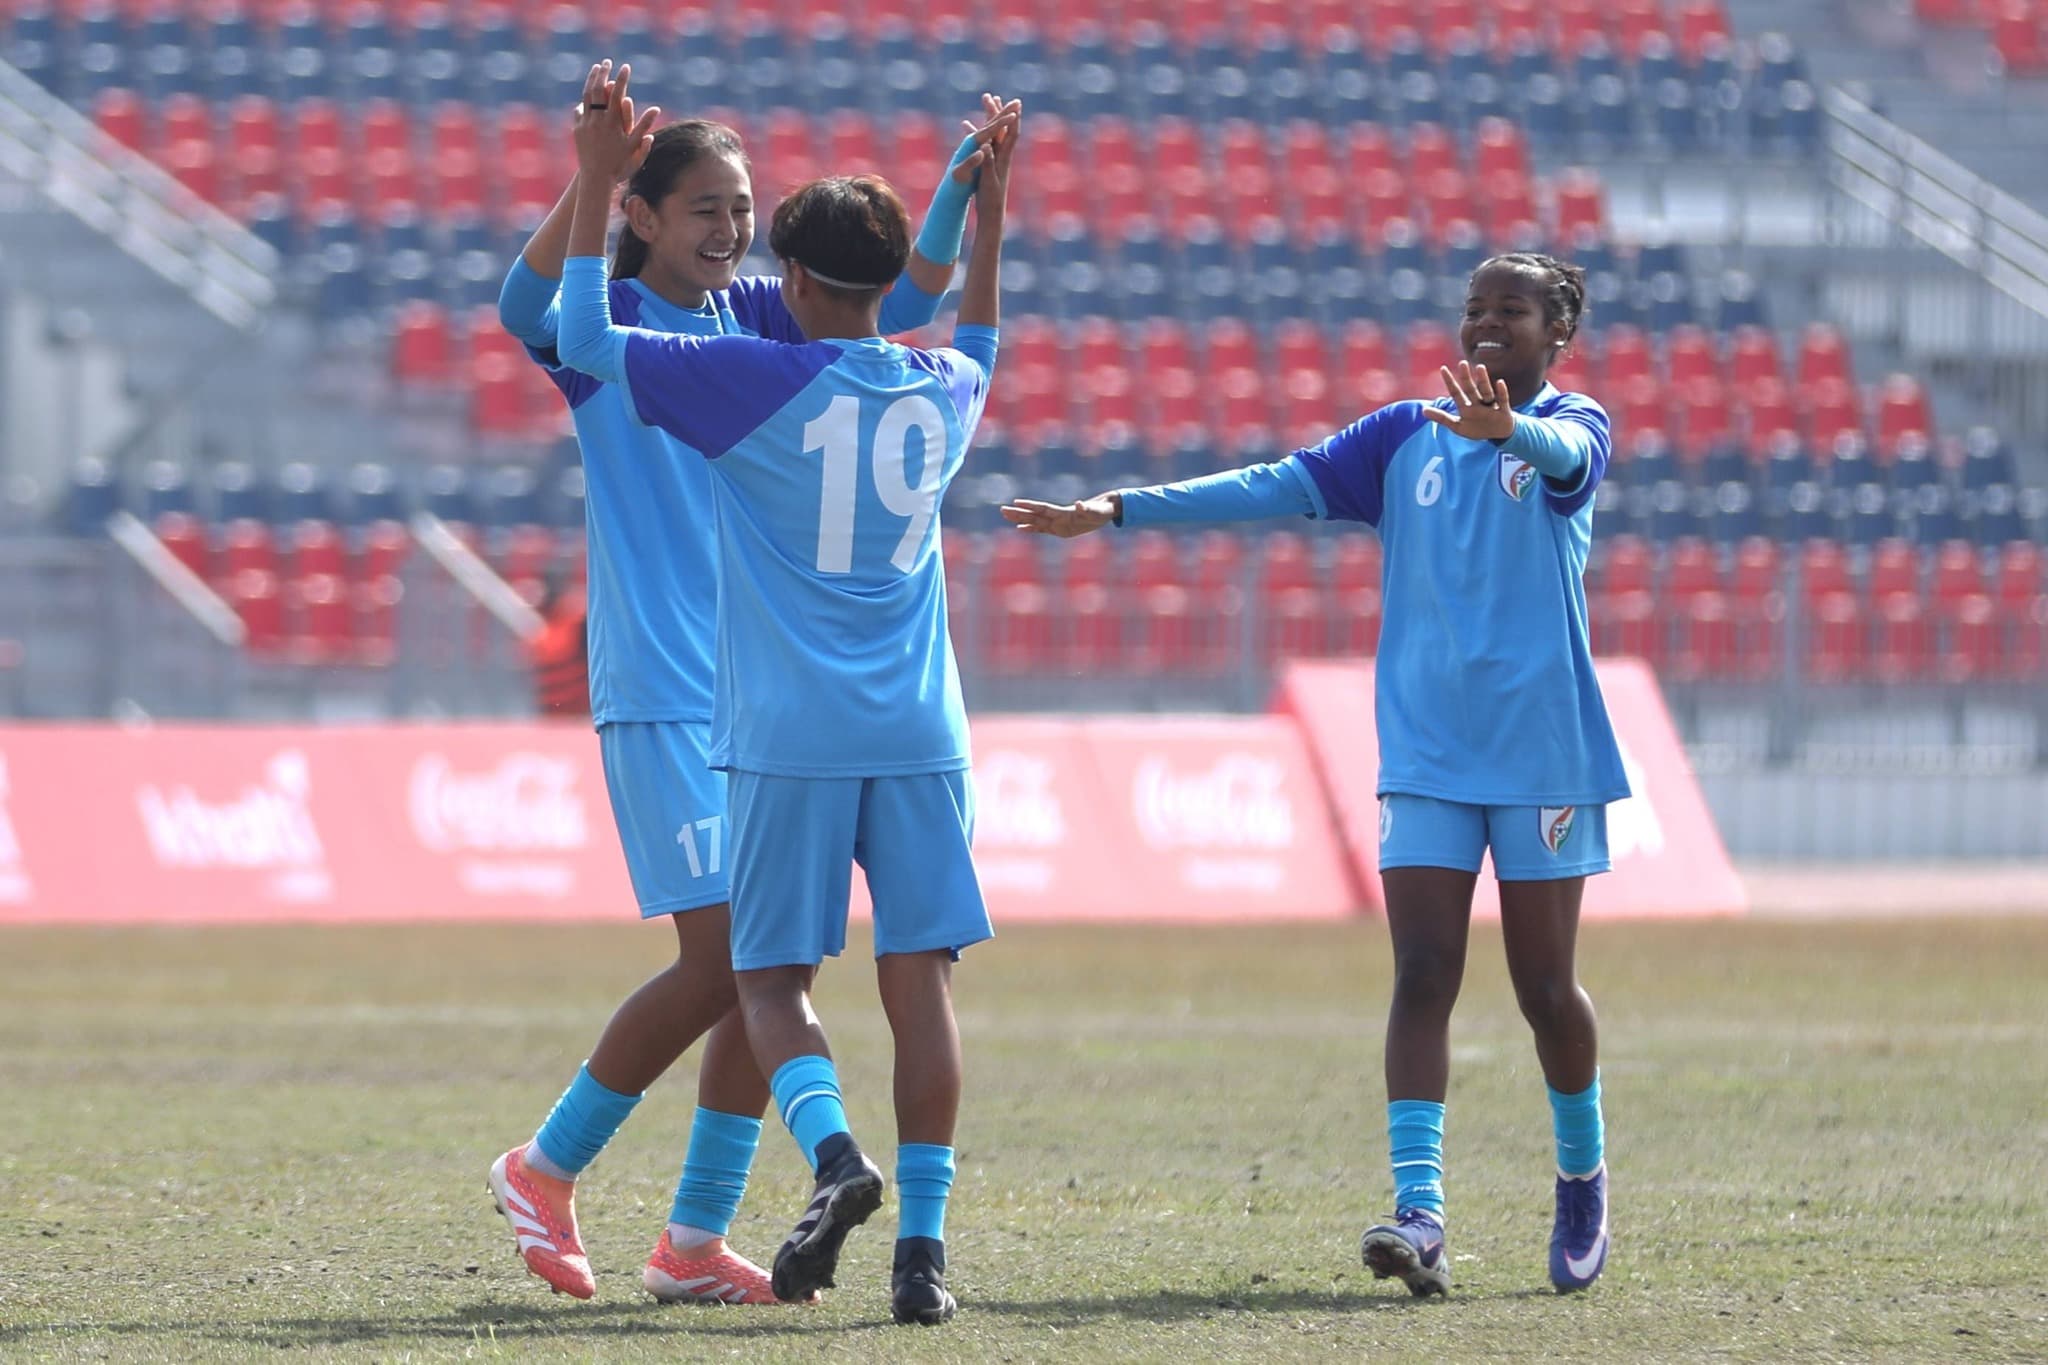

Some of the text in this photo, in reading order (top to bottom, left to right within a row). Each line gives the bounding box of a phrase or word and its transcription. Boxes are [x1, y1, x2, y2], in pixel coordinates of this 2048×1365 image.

[803, 395, 947, 575] 19
[1415, 456, 1445, 507] 6
[676, 816, 722, 879] 17
